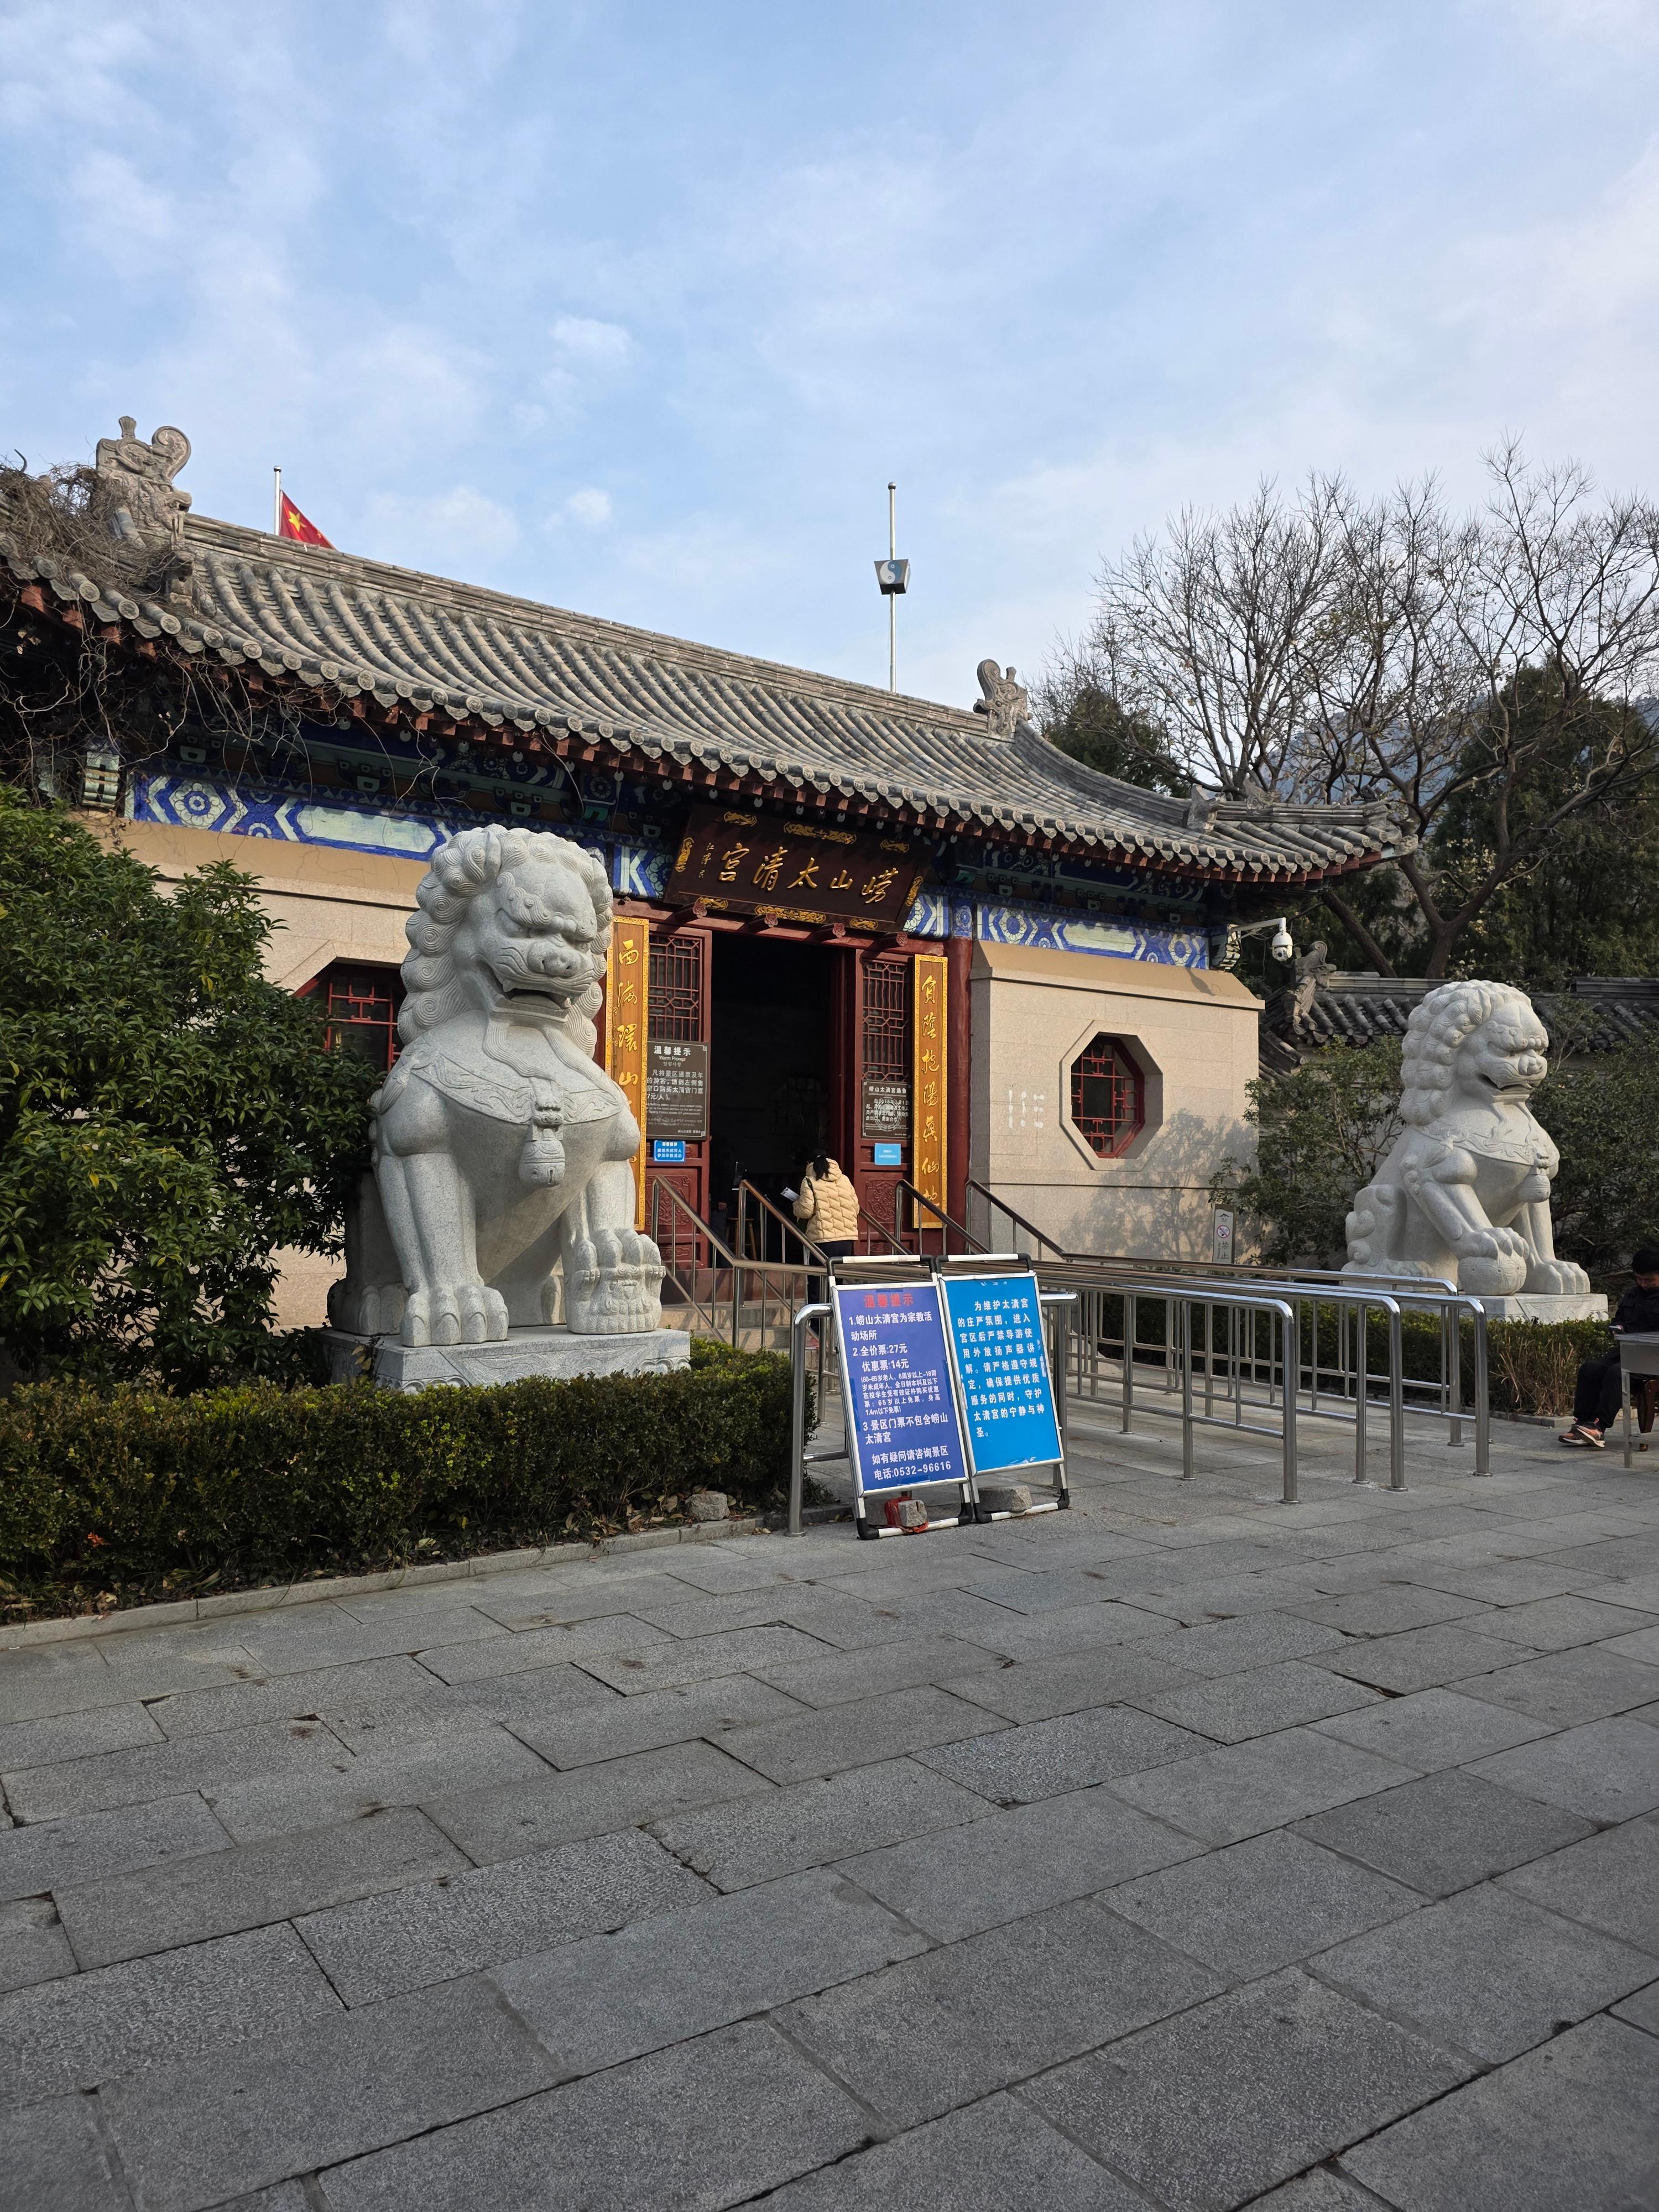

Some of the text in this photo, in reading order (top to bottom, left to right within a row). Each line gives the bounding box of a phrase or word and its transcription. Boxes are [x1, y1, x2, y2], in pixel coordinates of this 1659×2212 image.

[654, 1045, 691, 1056] 温馨提示
[864, 1293, 914, 1308] 温馨提示
[974, 1298, 1028, 1311] 为维护太清宫
[849, 1311, 932, 1326] 1.崂山太清宫为宗教活
[957, 1313, 1030, 1328] 的庄严氛围，进入
[851, 1329, 877, 1342] 动场所
[959, 1328, 1032, 1343] 宫区后严禁导游使
[963, 1343, 1035, 1359] 用外放扬声器讲
[862, 1358, 910, 1372] 优惠票:14元
[965, 1358, 1038, 1374] 解。请严格遵守规
[968, 1373, 1040, 1390] 定，确保提供优质
[863, 1385, 939, 1400] 在校学生凭有效证件购买优惠
[971, 1388, 1042, 1406] 服务的同时，守护
[973, 1403, 1045, 1422] 太清宫的宁静与神
[863, 1412, 948, 1431] 3.景区门票不包含崂山
[865, 1431, 891, 1445] 太清宫
[976, 1427, 989, 1438] 圣。
[872, 1446, 948, 1465] 如有疑问请咨询景区
[874, 1460, 951, 1480] 电话:0532-96616
